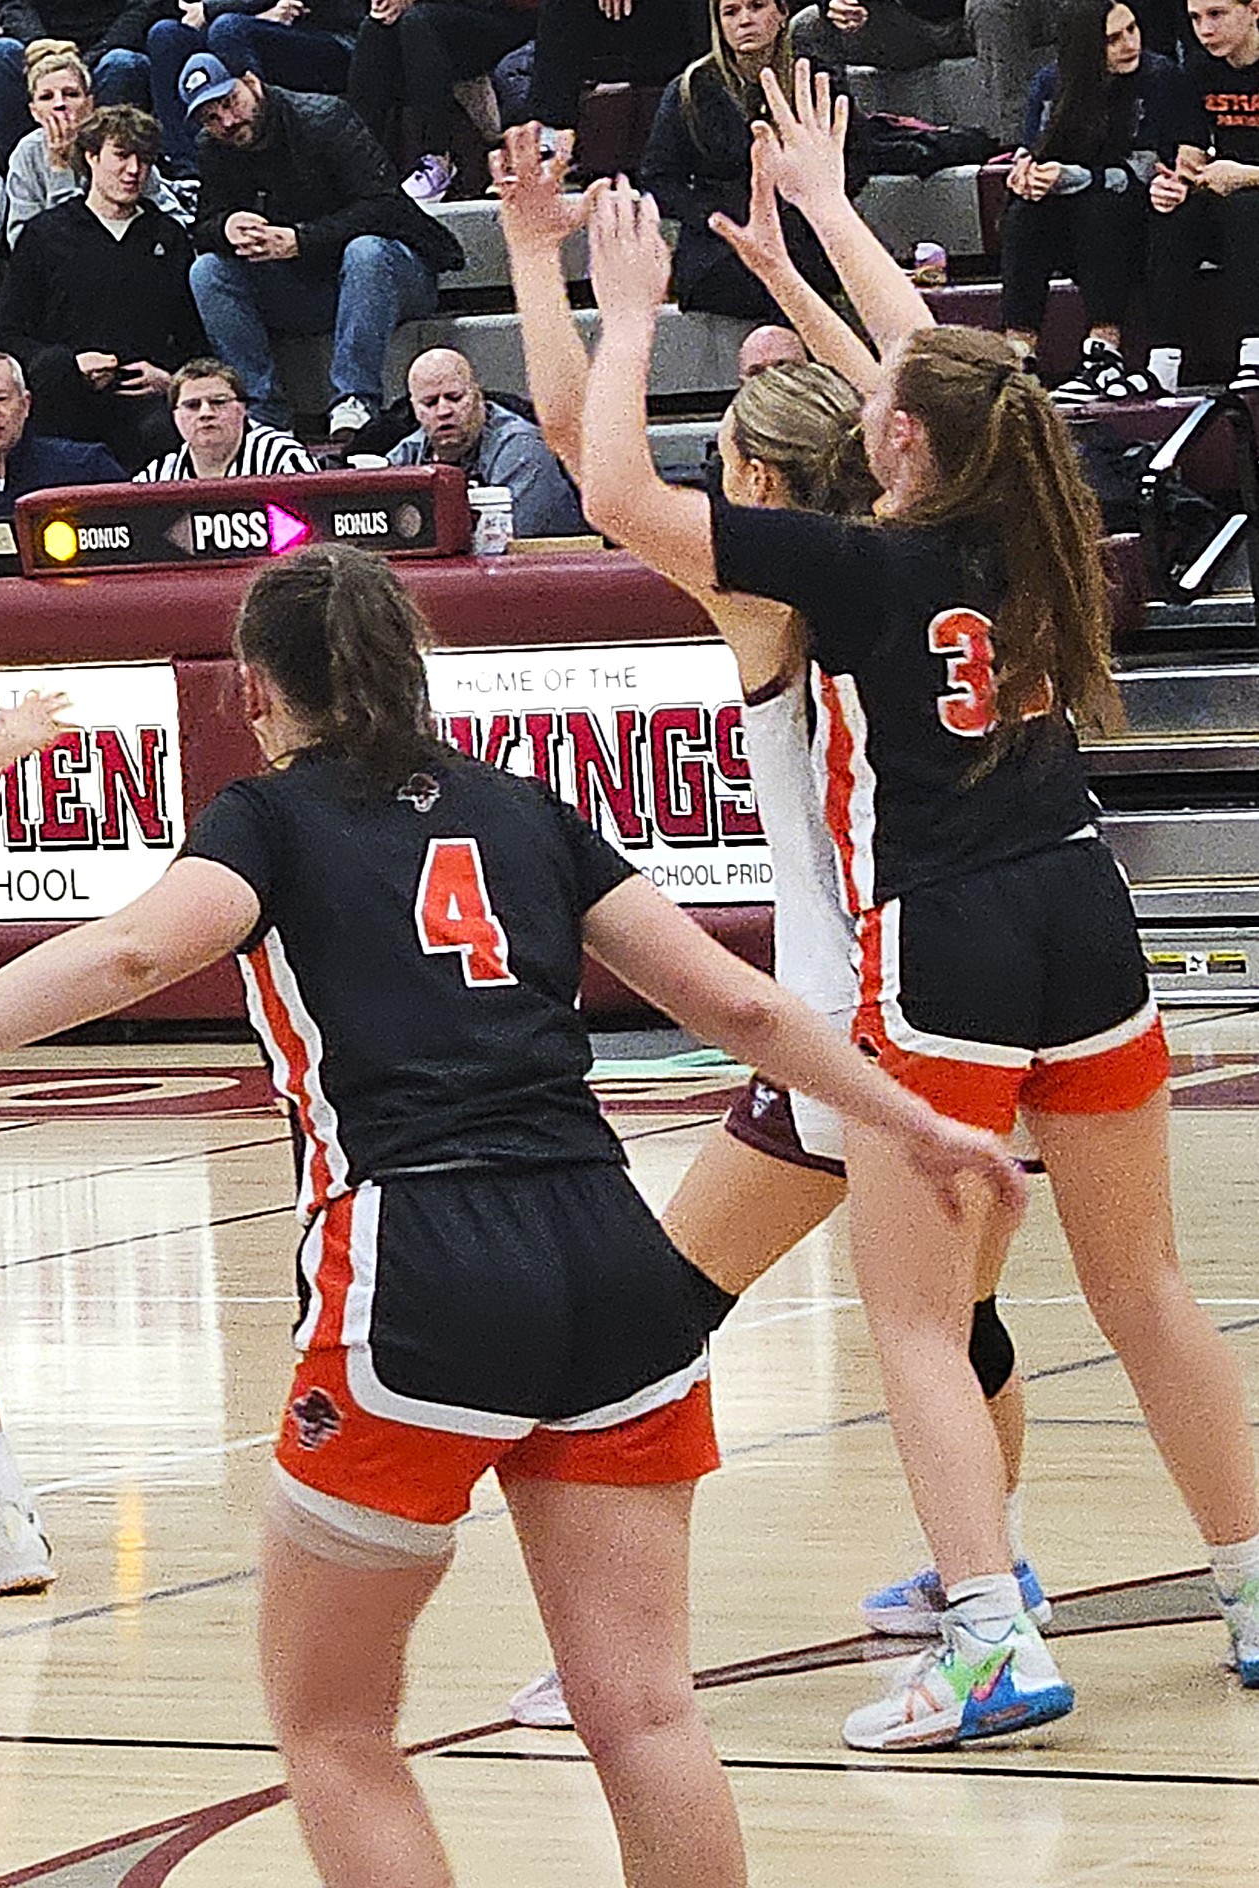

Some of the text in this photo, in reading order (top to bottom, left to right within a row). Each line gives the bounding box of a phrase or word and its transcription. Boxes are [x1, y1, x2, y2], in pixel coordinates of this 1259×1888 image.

[78, 511, 389, 551] BONUS POSS BONUS
[457, 666, 637, 693] HOME OF THE
[726, 863, 773, 885] PRID
[414, 837, 519, 988] 4
